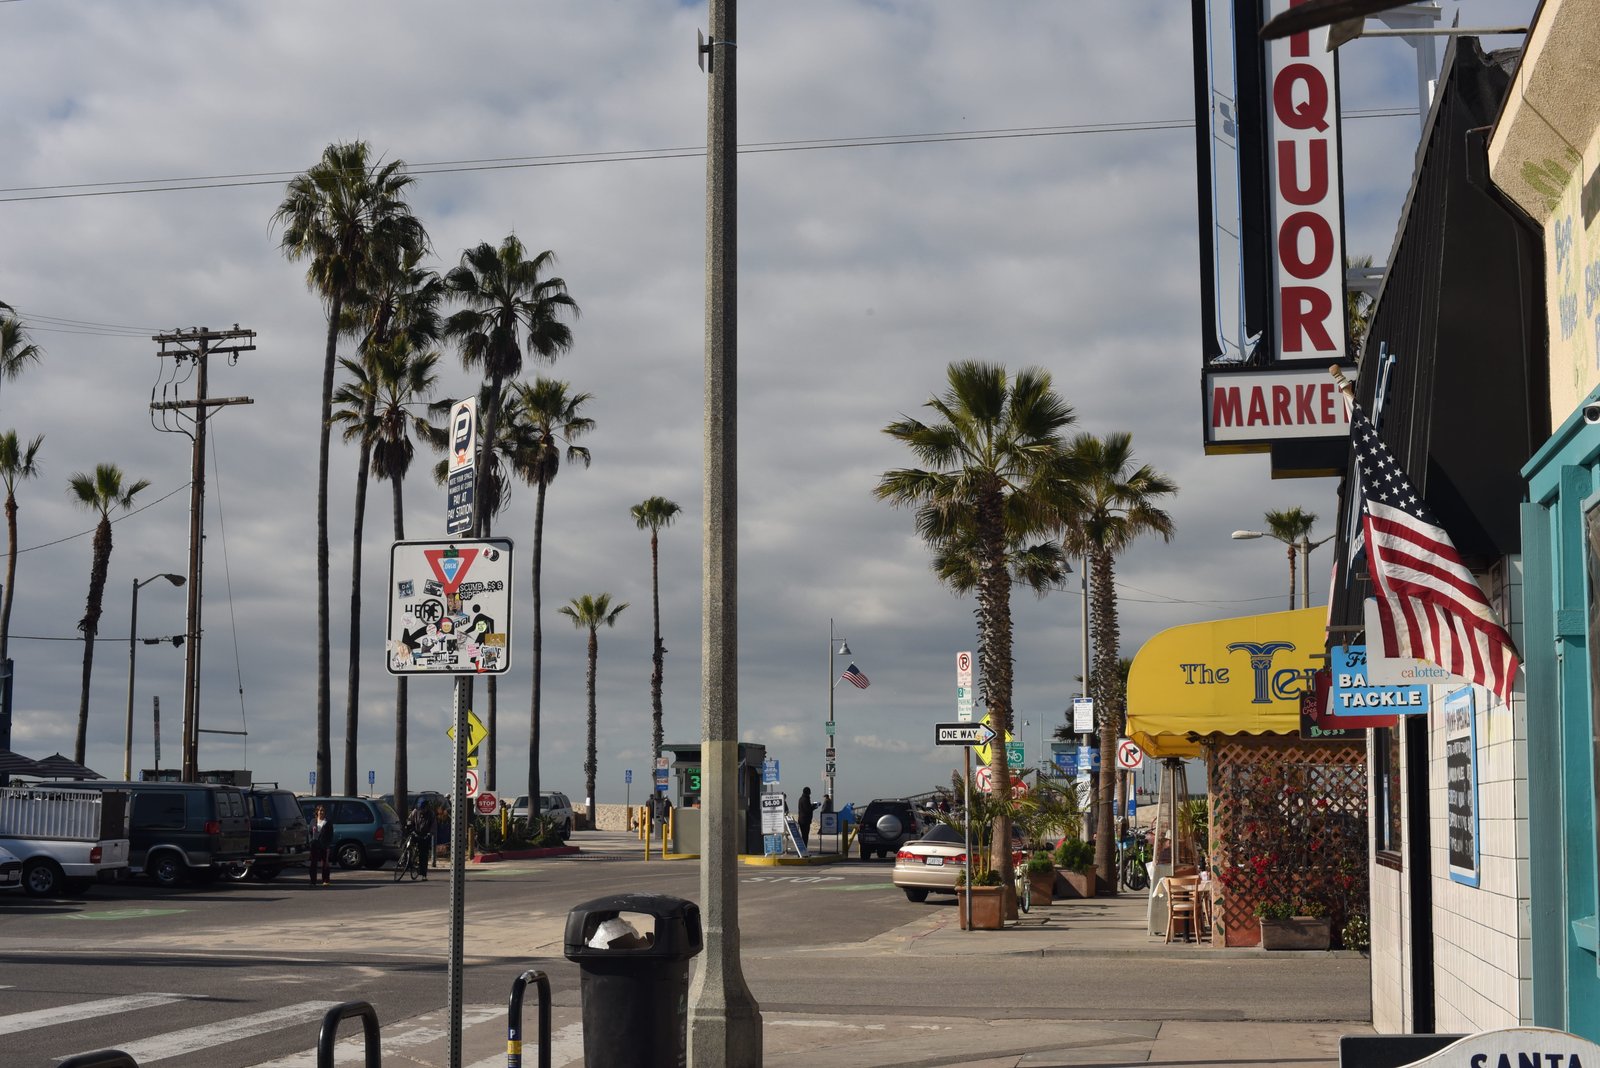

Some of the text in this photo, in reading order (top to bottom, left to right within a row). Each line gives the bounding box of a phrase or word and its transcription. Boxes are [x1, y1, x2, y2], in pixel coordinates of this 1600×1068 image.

[1212, 383, 1350, 428] MARKE
[453, 492, 468, 506] PAY AT
[448, 502, 473, 520] PAY STATION
[1345, 651, 1367, 668] Fi
[1179, 663, 1230, 684] The
[1226, 641, 1315, 703] Te
[1401, 666, 1451, 680] calottery
[1339, 691, 1422, 708] TACKLE
[941, 730, 978, 740] ONE WAY
[1310, 726, 1346, 738] Dess
[510, 1030, 516, 1038] P
[1470, 1052, 1583, 1068] SANTA
